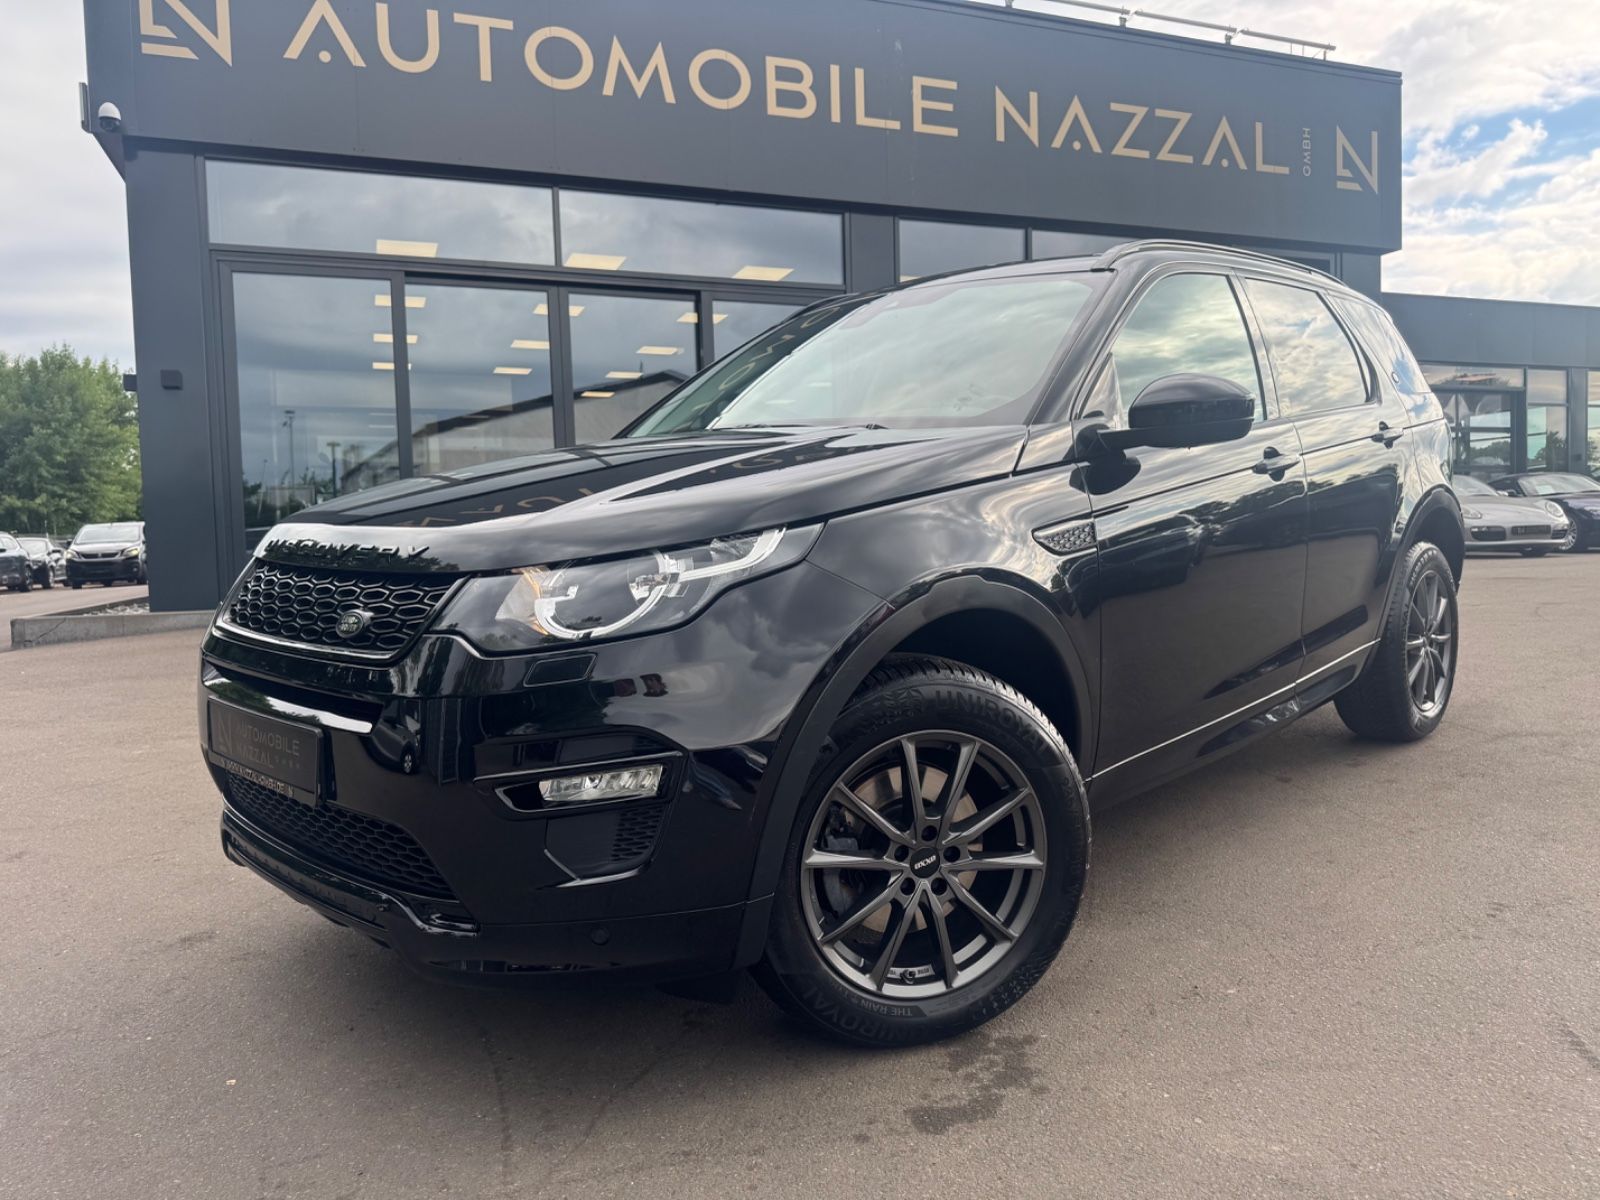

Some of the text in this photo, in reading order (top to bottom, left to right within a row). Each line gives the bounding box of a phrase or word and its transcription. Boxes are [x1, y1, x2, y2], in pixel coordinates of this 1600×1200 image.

[283, 0, 1289, 175] AUTOMOBILE NAZZAL
[860, 999, 888, 1016] RAIN
[890, 1005, 913, 1017] THE
